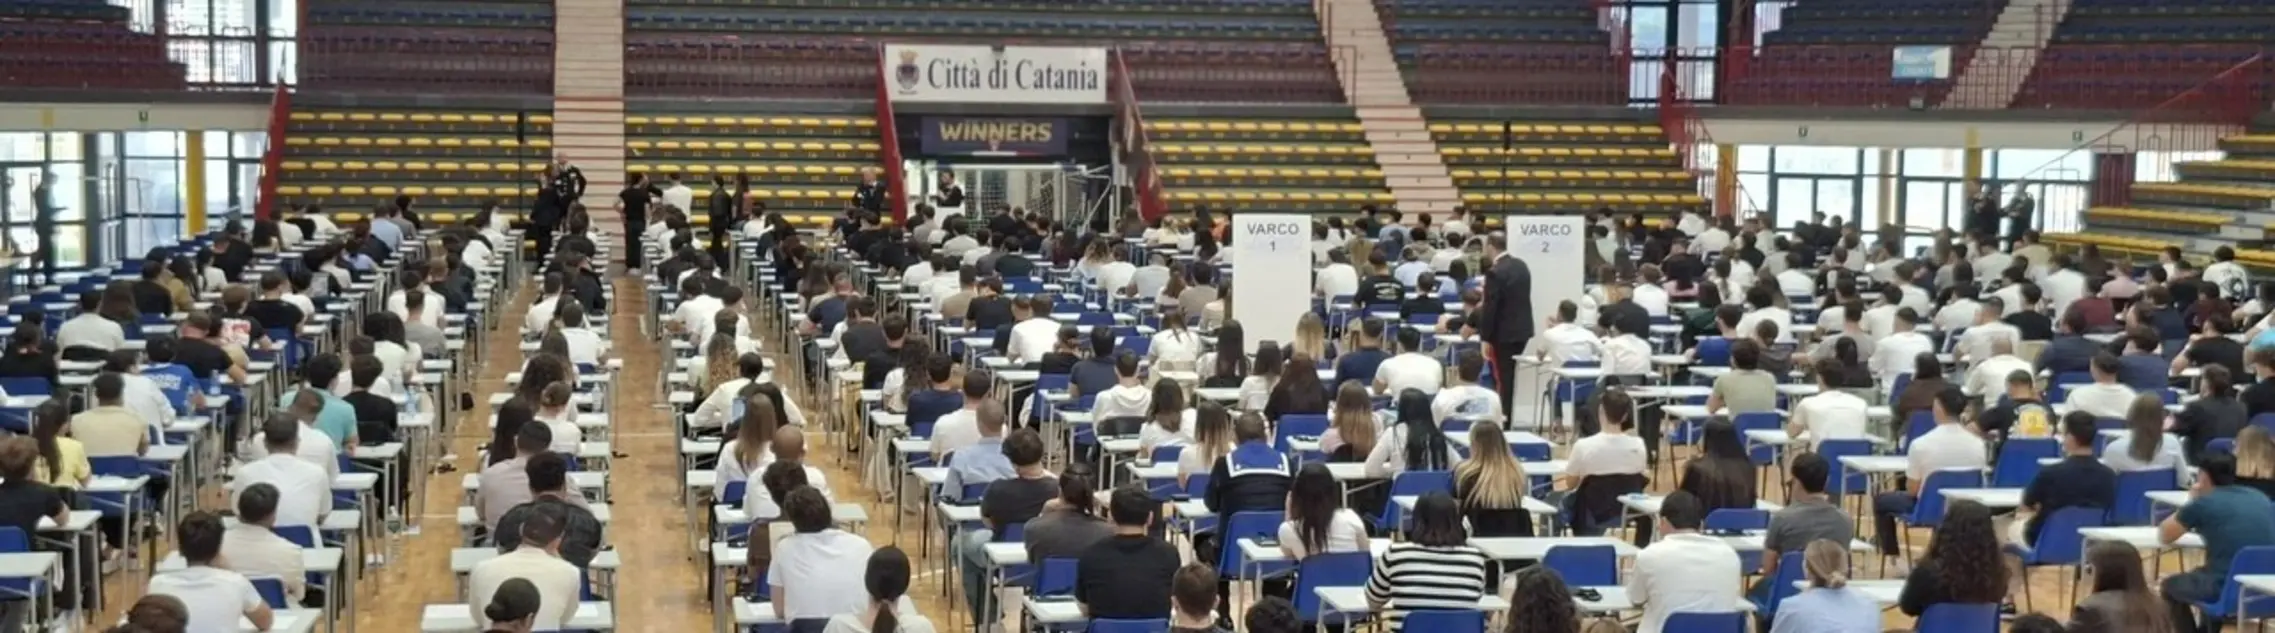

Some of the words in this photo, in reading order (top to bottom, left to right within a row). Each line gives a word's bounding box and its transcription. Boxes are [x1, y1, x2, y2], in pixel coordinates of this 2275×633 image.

[927, 58, 980, 90] Città
[988, 58, 1008, 90] di
[1015, 58, 1099, 91] Catania
[939, 121, 1053, 142] WINNERS
[1247, 222, 1300, 236] VARCO
[1519, 223, 1572, 236] VARCO
[1269, 240, 1276, 253] 1
[1540, 240, 1550, 253] 2
